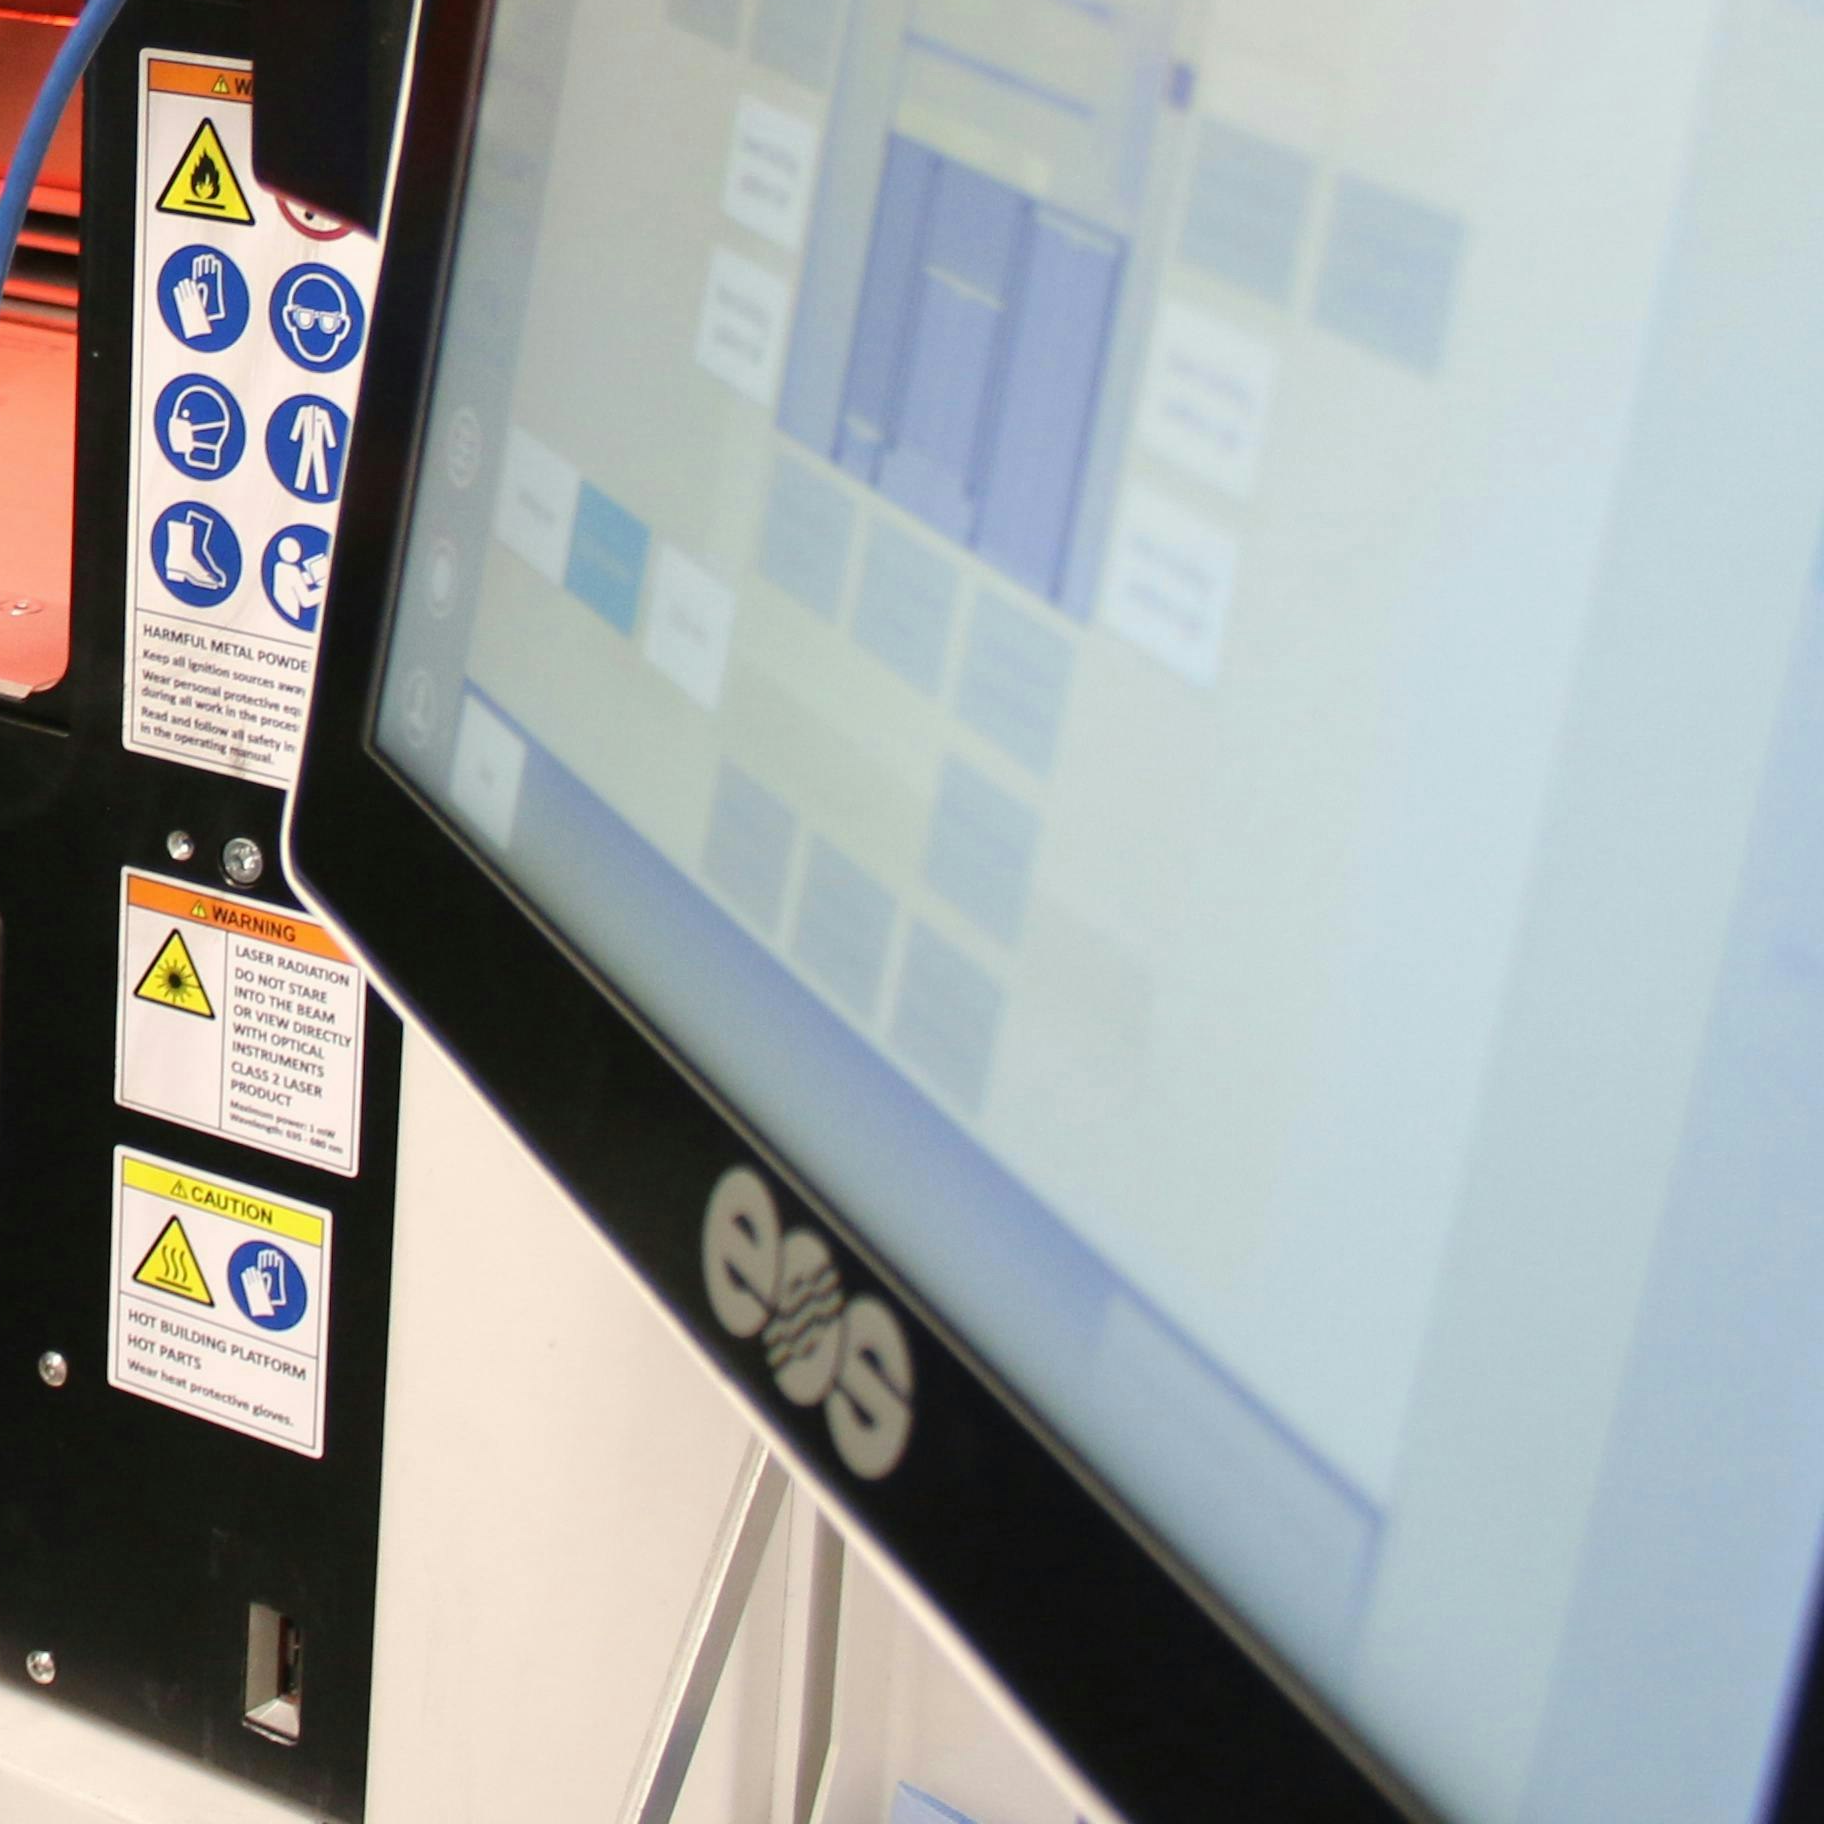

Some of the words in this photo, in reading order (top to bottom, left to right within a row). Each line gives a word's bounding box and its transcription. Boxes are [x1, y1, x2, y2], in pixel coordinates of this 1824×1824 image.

[143, 623, 208, 650] HARMFUL
[210, 640, 255, 661] METAL
[142, 649, 170, 666] Keep
[172, 654, 186, 667] all
[233, 670, 276, 690] sources
[141, 686, 177, 706] during
[179, 694, 193, 708] all
[195, 699, 224, 716] work
[226, 703, 237, 717] in
[239, 708, 258, 724] the
[142, 668, 172, 685] Wear
[173, 676, 222, 699] personal
[224, 689, 281, 712] protective
[141, 706, 168, 723] Read
[171, 712, 192, 729] and
[194, 718, 230, 738] follow
[231, 728, 245, 742] all
[247, 732, 281, 753] safety
[283, 741, 297, 754] in
[154, 725, 172, 741] the
[174, 731, 228, 756] operating
[212, 905, 296, 942] WARNING
[235, 967, 255, 984] DO
[258, 974, 286, 992] NOT
[289, 983, 328, 1004] STARE
[236, 945, 274, 968] LASER
[278, 957, 350, 988] RADIATION
[234, 986, 266, 1005] INTO
[269, 994, 293, 1013] THE
[297, 1002, 336, 1025] BEAM
[233, 1004, 253, 1020] OR
[256, 1010, 290, 1031] VIEW
[293, 1020, 352, 1049] DIRECTLY
[233, 1022, 268, 1043] WITH
[271, 1034, 325, 1061] OPTICAL
[232, 1040, 325, 1078] INSTRUMENTS
[230, 1079, 293, 1108] PRODUCT
[231, 1061, 270, 1083] CLASS
[272, 1073, 281, 1086] 2
[283, 1076, 323, 1099] LASER
[230, 1099, 274, 1121] Maximum
[191, 1185, 274, 1225] CAUTION
[127, 1334, 157, 1355] HOT
[159, 1344, 202, 1371] PARTS
[128, 1308, 158, 1330] HOT
[160, 1317, 227, 1354] BUILDING
[230, 1344, 307, 1381] PLATFORM
[127, 1358, 159, 1379] Wear
[161, 1369, 187, 1390] heat
[189, 1376, 250, 1411] protective
